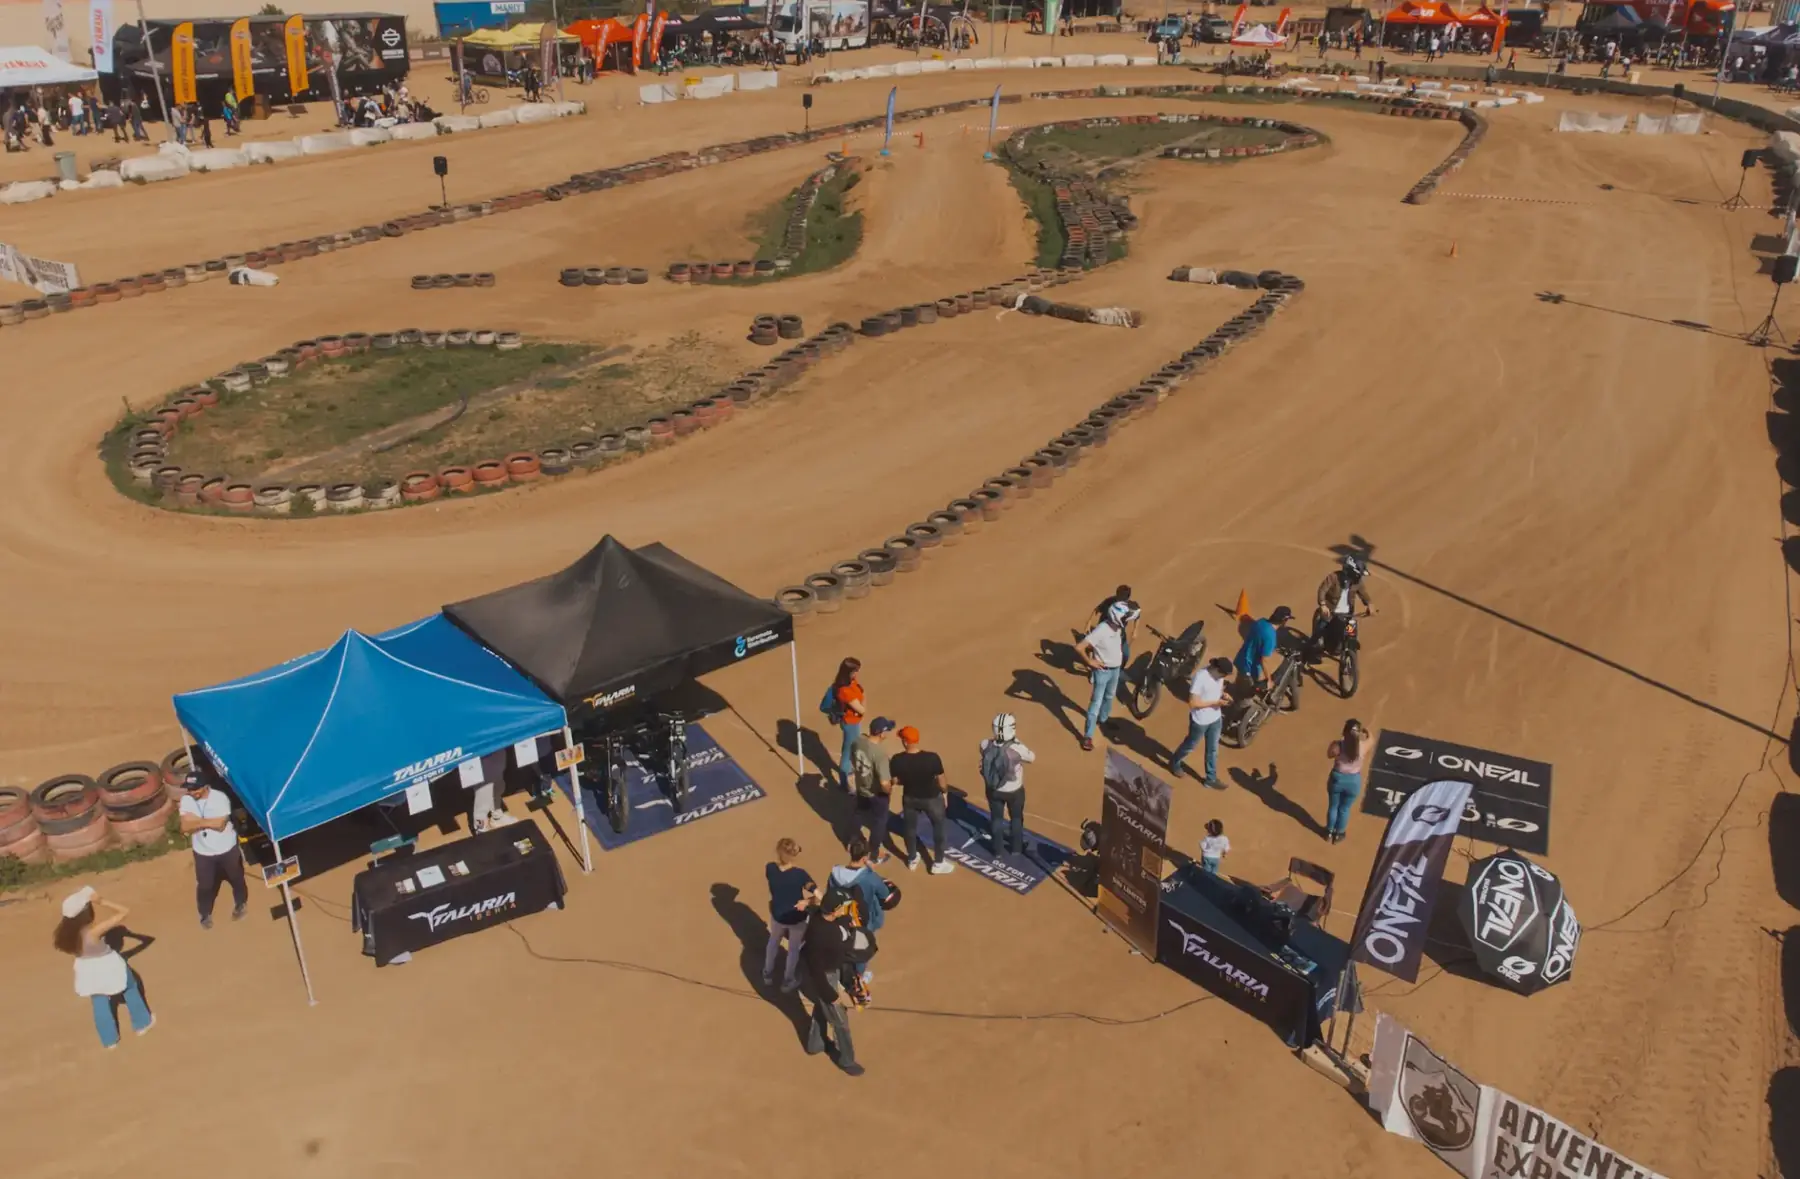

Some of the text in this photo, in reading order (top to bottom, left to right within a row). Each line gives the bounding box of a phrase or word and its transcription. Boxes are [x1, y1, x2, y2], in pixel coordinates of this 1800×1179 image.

[393, 746, 463, 782] TALARIA
[673, 789, 761, 825] TALARIA
[710, 794, 724, 802] GO
[725, 787, 744, 797] FOR
[1118, 808, 1164, 846] TALARIA
[943, 847, 1029, 891] TALARIA
[992, 859, 1007, 869] GO
[1007, 866, 1025, 878] FOR
[432, 891, 516, 928] TALARIA
[1186, 940, 1269, 997] TALARIA
